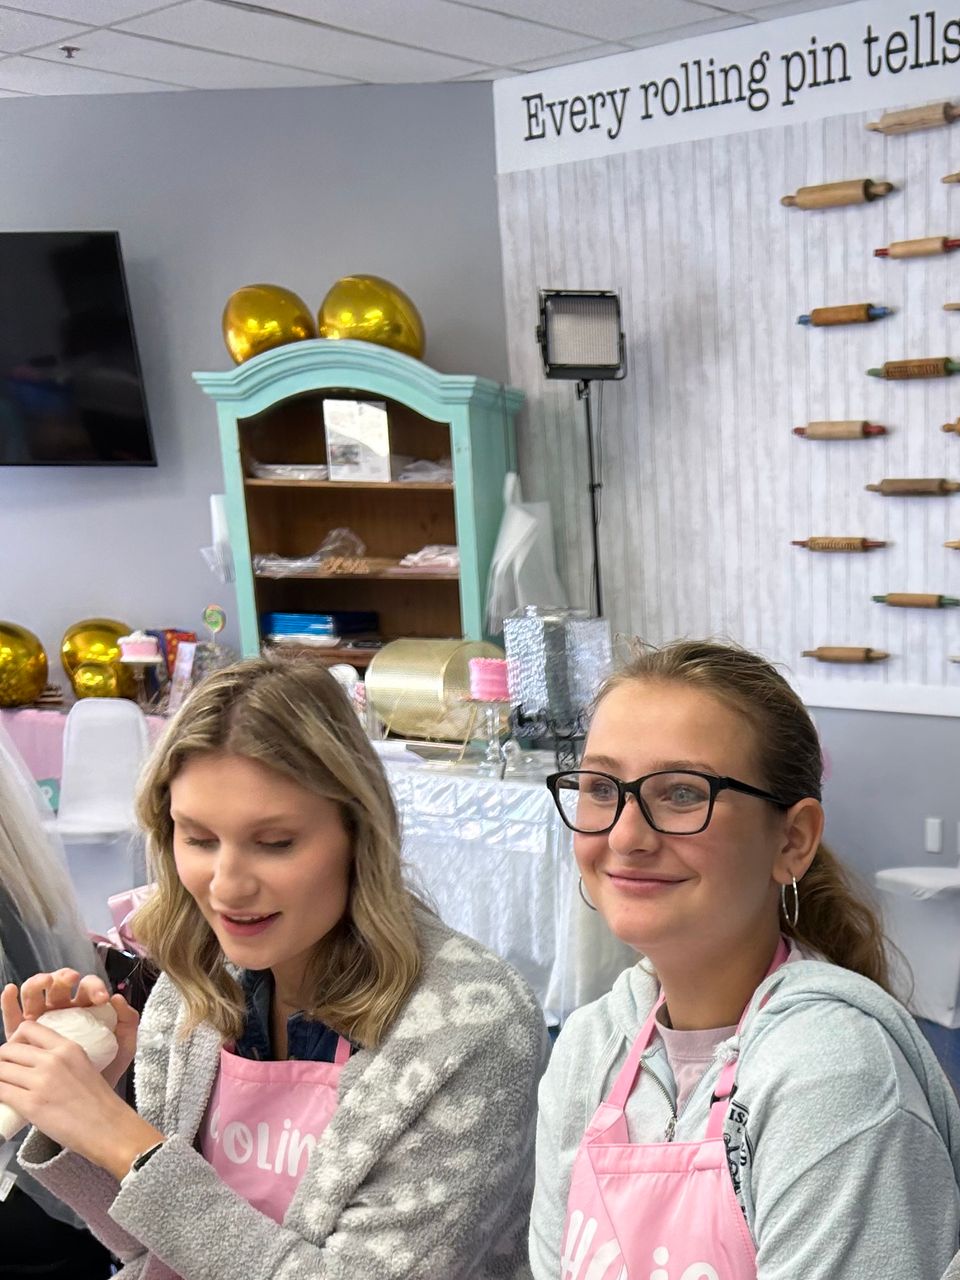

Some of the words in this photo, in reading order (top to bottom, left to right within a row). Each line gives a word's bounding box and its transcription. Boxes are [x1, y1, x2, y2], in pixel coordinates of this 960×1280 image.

[522, 92, 630, 141] Every
[639, 50, 770, 112] rolling
[781, 36, 851, 106] pin
